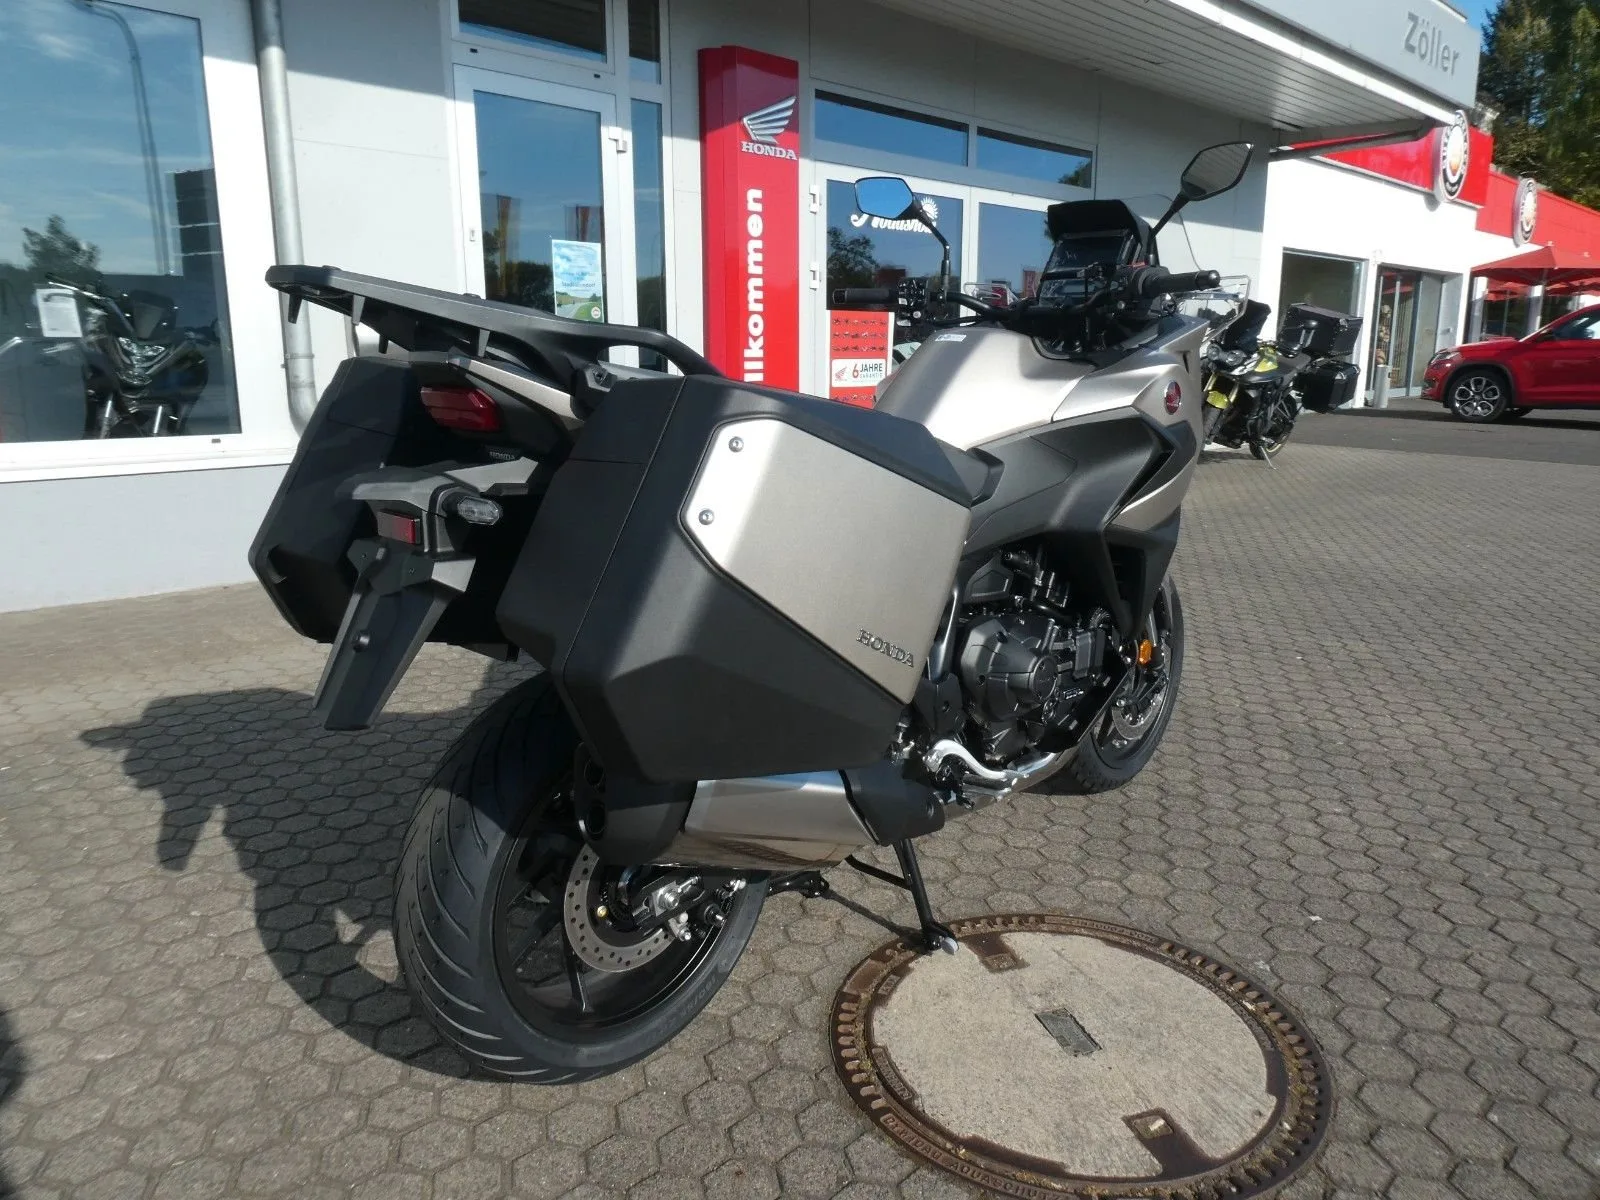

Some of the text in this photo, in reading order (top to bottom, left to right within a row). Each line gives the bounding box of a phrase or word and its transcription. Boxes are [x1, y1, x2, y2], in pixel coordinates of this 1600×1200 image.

[1404, 10, 1460, 77] Zöller
[741, 141, 798, 161] HONDA
[743, 188, 764, 382] llkommen
[852, 363, 883, 379] 6 JAHRE
[856, 629, 914, 668] HONDA
